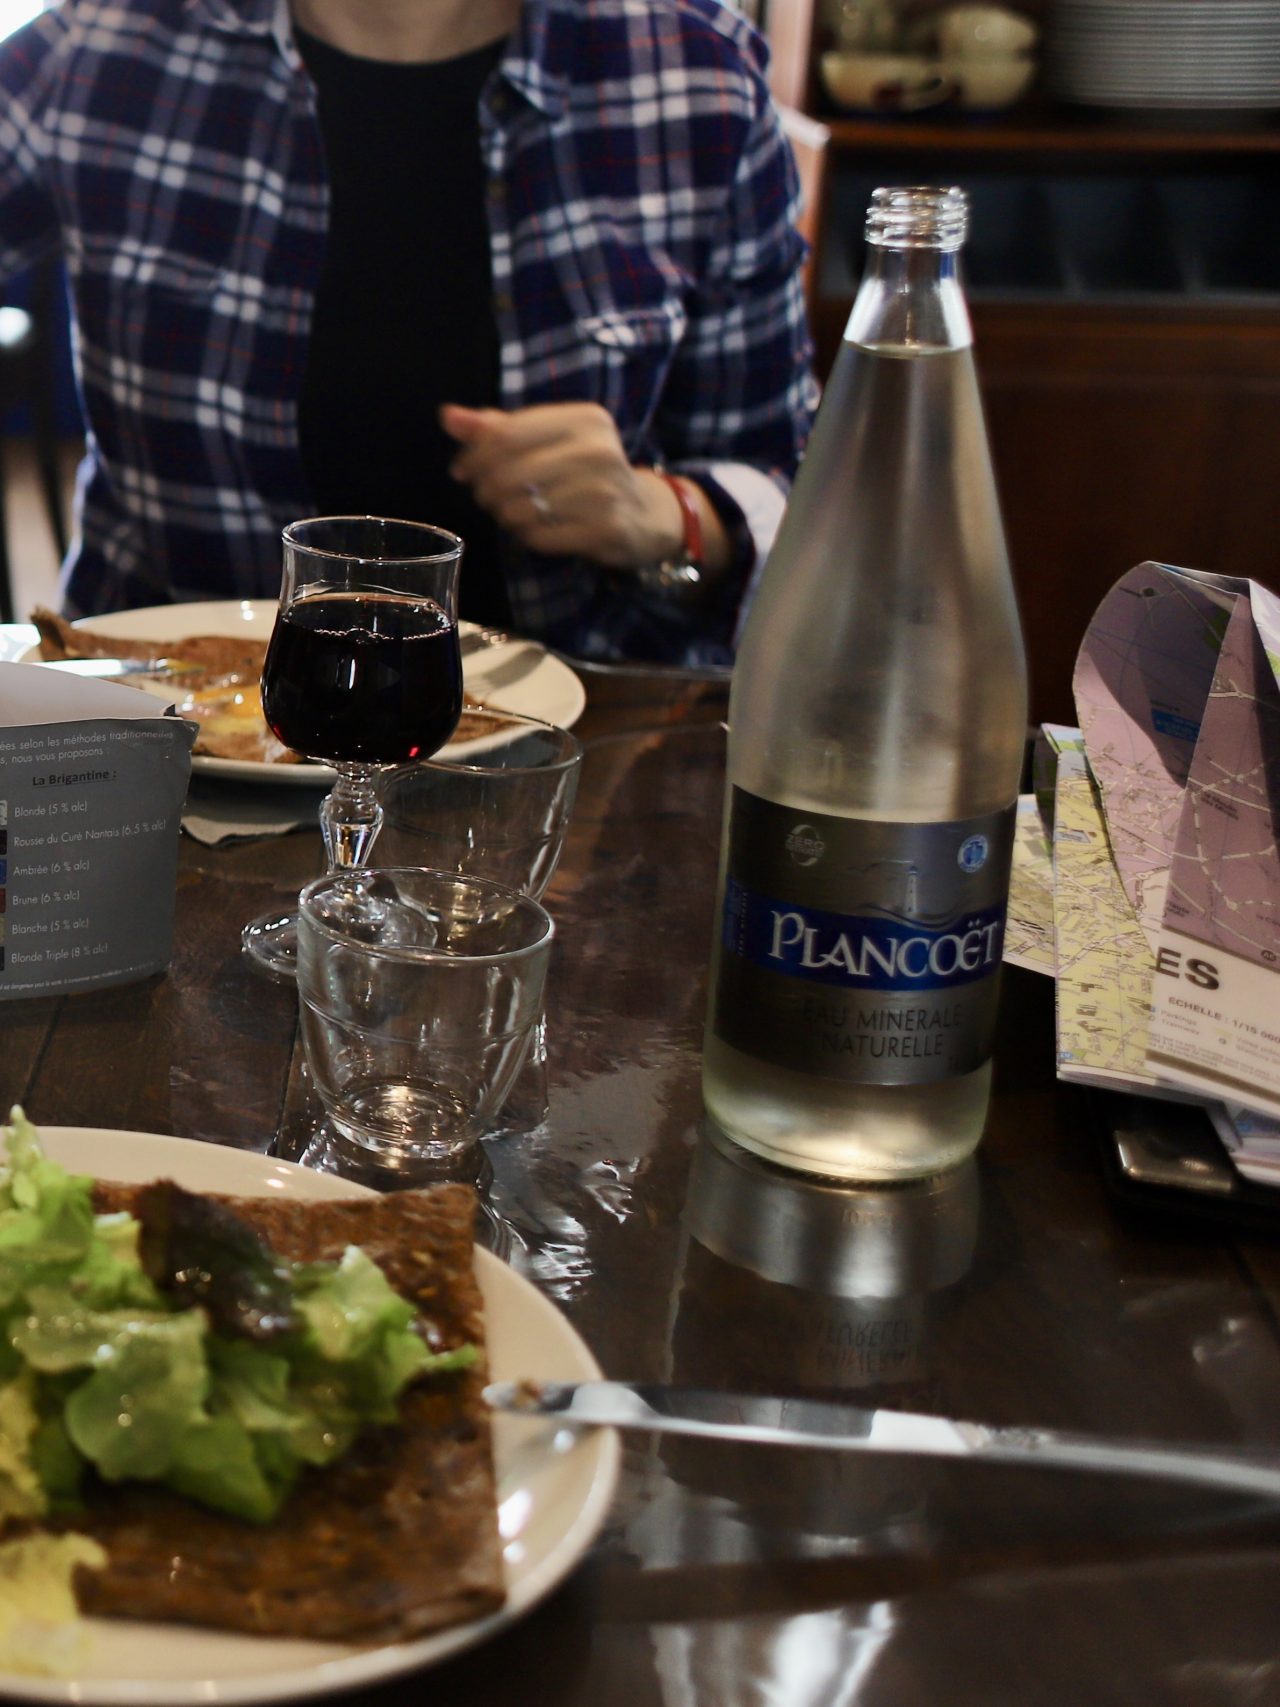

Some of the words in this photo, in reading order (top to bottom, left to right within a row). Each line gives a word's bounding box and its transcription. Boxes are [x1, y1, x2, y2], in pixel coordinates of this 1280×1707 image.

[19, 740, 45, 751] selon
[47, 736, 61, 748] les
[63, 733, 108, 746] méthodes
[11, 754, 33, 764] nous
[35, 752, 57, 762] vous
[58, 747, 104, 761] proposons
[32, 775, 46, 786] La
[48, 769, 111, 786] Brigantine
[14, 806, 47, 818] Blonde
[71, 800, 88, 813] alc)
[13, 836, 45, 848] Rousse
[46, 833, 59, 844] du
[61, 831, 83, 843] Curé
[85, 827, 120, 841] Nantais
[12, 865, 49, 877] Ambrée
[74, 859, 90, 872] alc)
[12, 894, 38, 906] Brune
[63, 889, 80, 902] alc)
[12, 922, 48, 935] Blanche
[767, 908, 999, 979] PLANCOËT
[11, 952, 43, 964] Blonde
[45, 949, 70, 962] Triple
[802, 1003, 848, 1027] EAU
[855, 1003, 963, 1032] MINERALE
[1167, 996, 1223, 1021] ECHELLE
[1231, 1018, 1258, 1036] 1/15
[821, 1033, 945, 1059] NATURELLE
